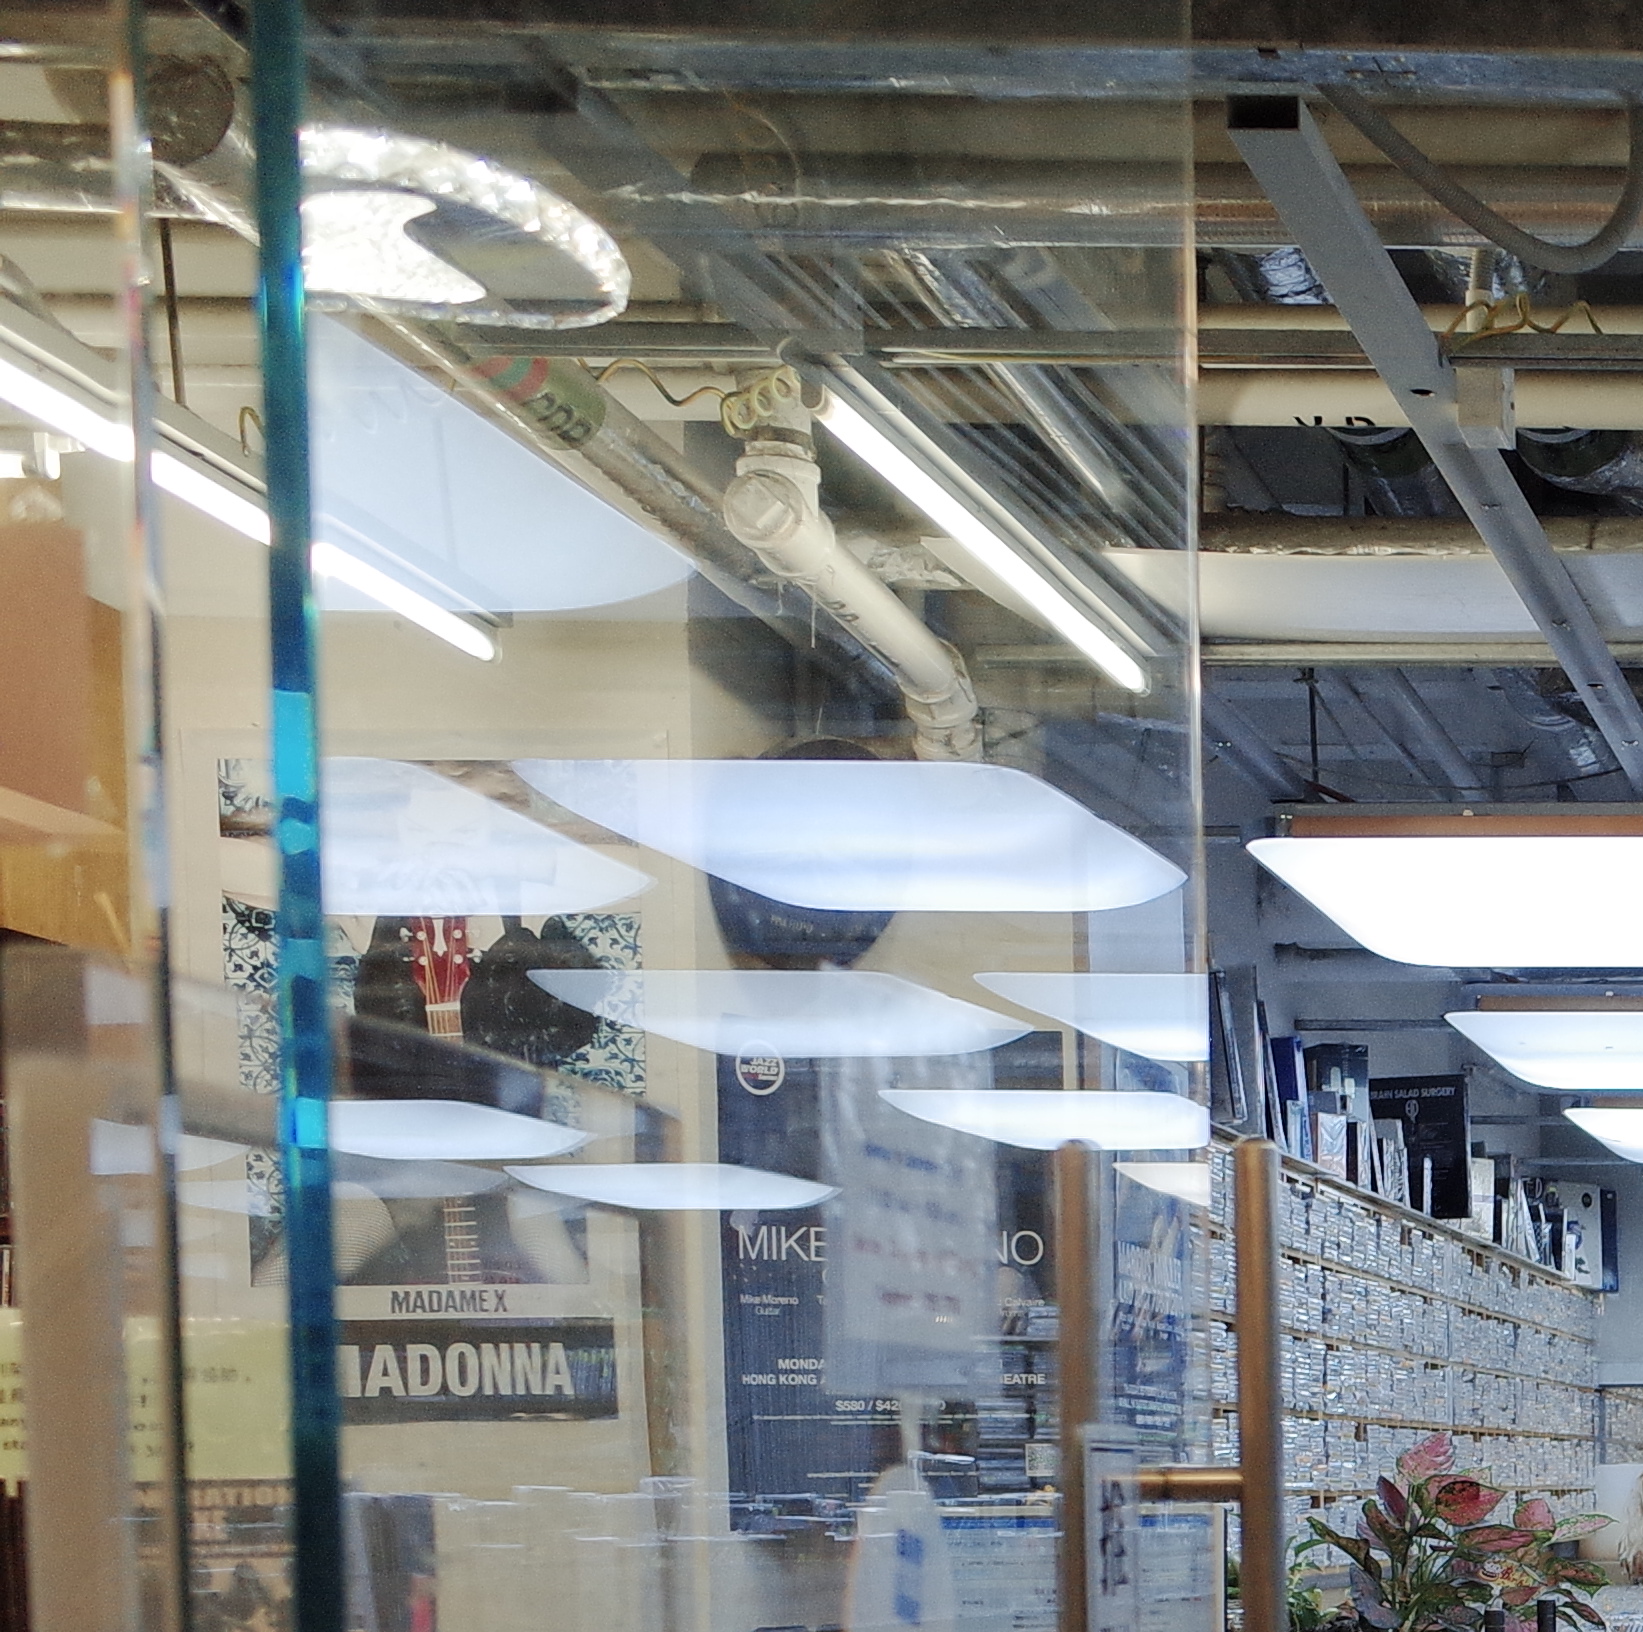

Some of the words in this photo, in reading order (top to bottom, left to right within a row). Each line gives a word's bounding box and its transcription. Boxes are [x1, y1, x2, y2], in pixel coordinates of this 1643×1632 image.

[741, 1064, 779, 1074] WORLD
[1395, 1088, 1419, 1099] SALAD
[1421, 1086, 1456, 1098] SURGERY
[738, 1226, 828, 1262] MIKE
[389, 1290, 488, 1314] MADAME
[493, 1289, 508, 1312] X
[777, 1358, 827, 1371] MONDA
[742, 1374, 775, 1385] HONG
[778, 1374, 817, 1385] KONG
[1001, 1373, 1046, 1385] EATRE
[875, 1401, 901, 1411] $42
